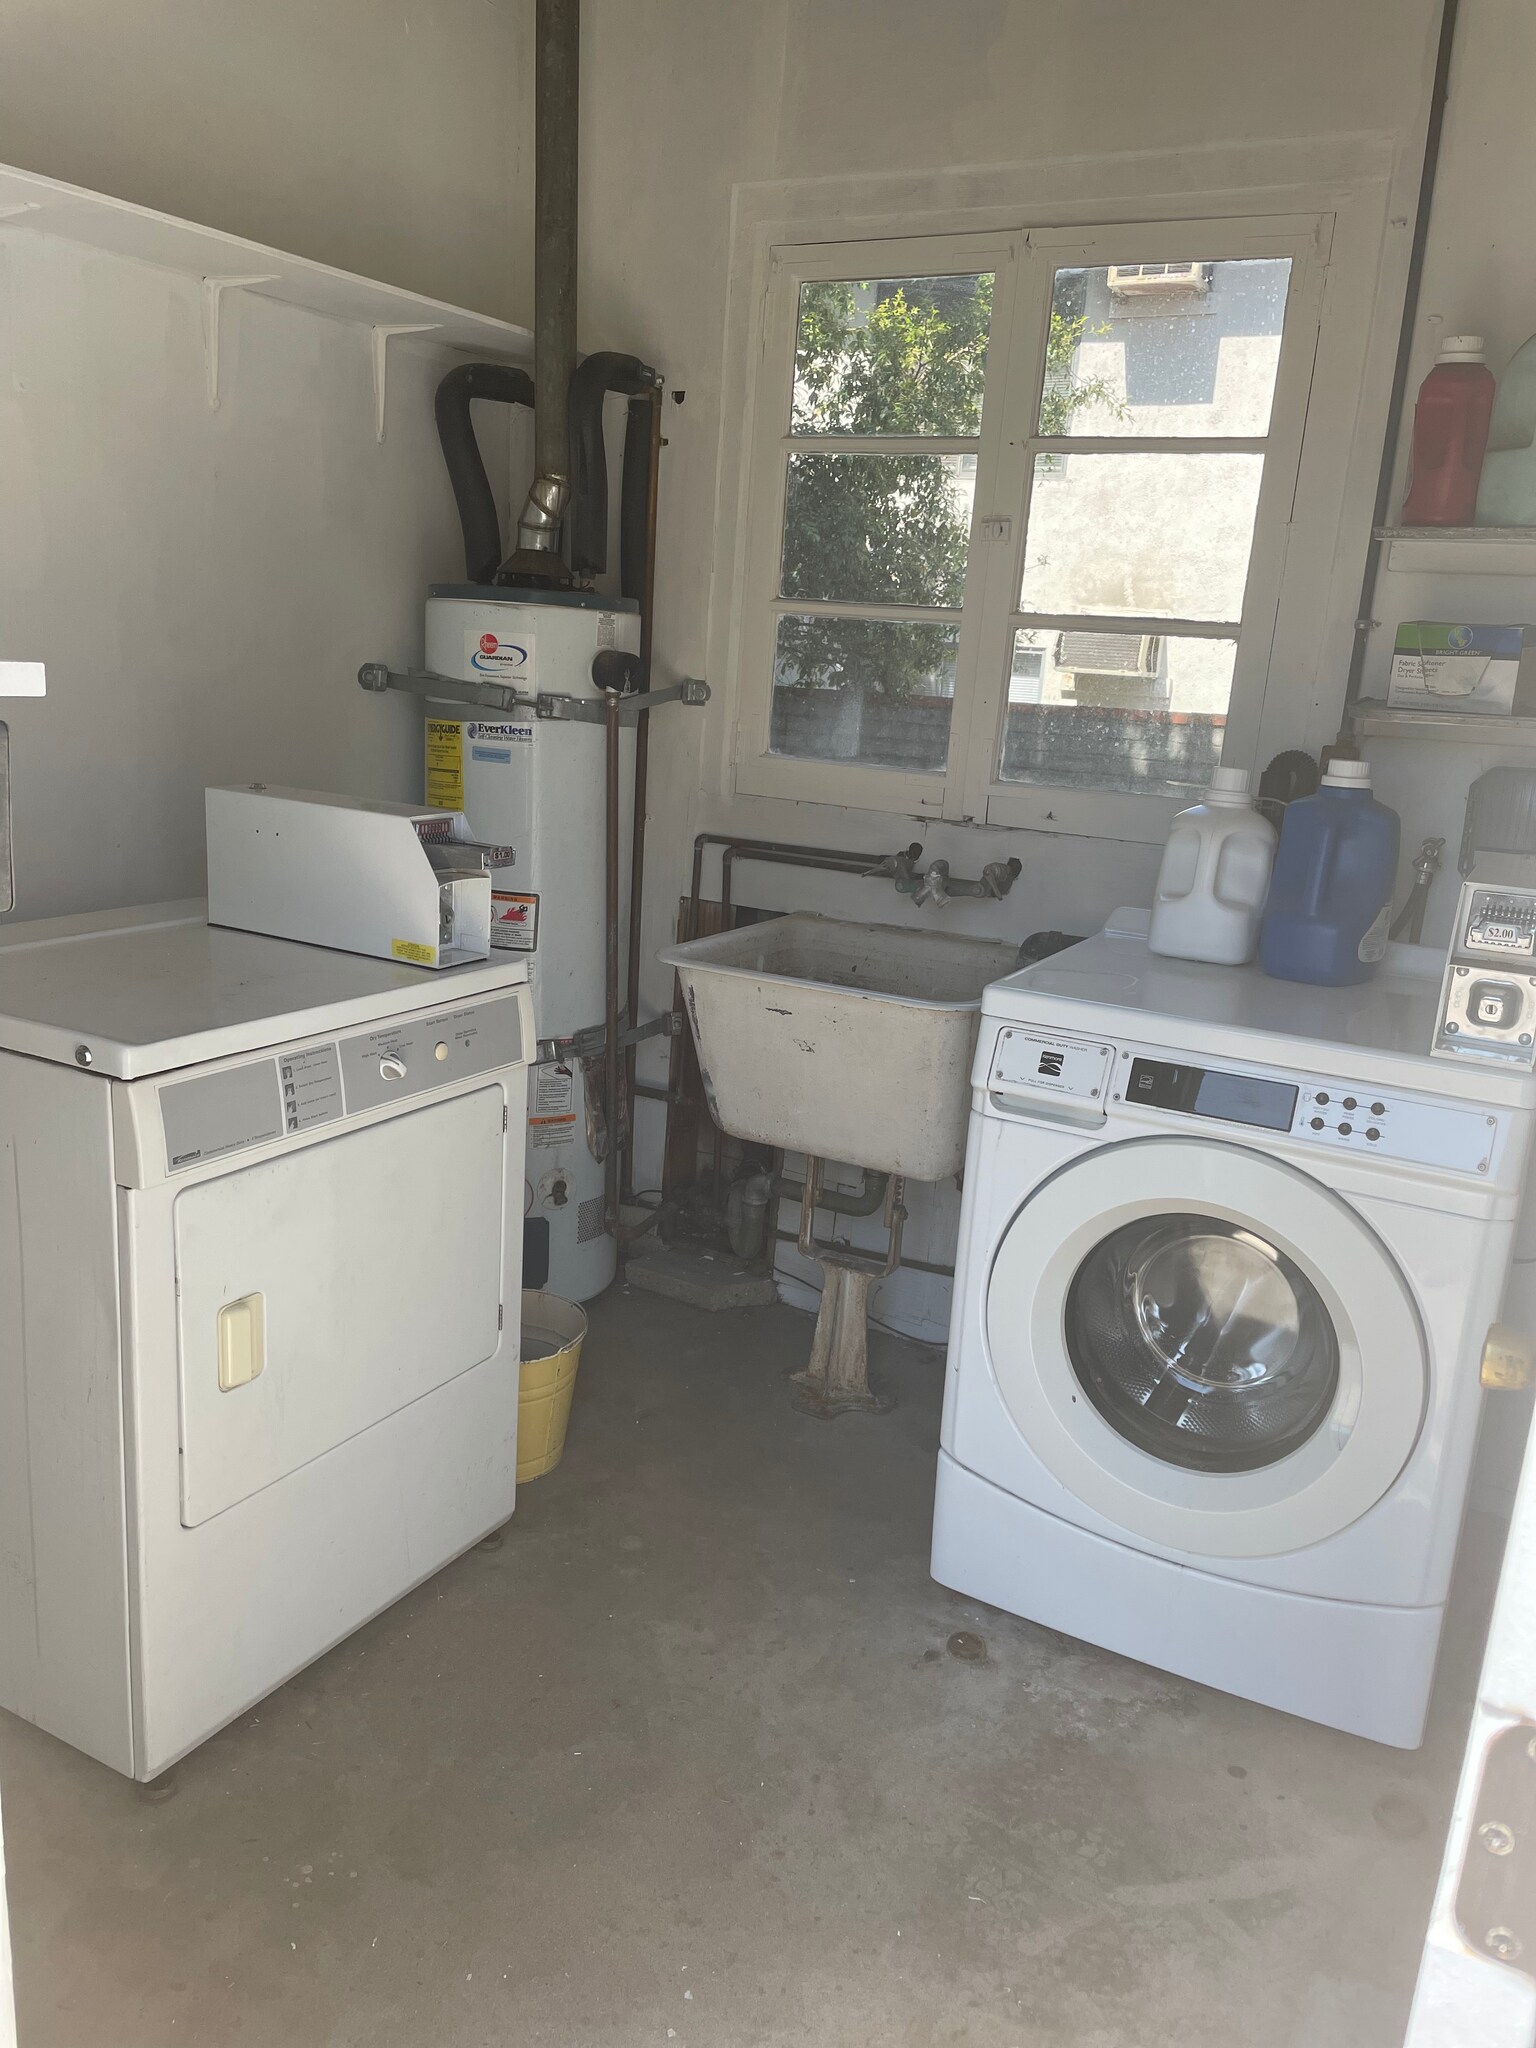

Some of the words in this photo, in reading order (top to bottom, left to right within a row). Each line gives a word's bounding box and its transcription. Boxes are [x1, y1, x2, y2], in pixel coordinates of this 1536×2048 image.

[1397, 667, 1415, 675] Dryer
[478, 723, 532, 736] EverKleen
[495, 851, 511, 859] $1.00
[1488, 927, 1514, 939] $2.00
[377, 1030, 402, 1039] Temperature
[1024, 1037, 1055, 1046] COMMERCIAL
[283, 1053, 306, 1063] Operating
[306, 1047, 331, 1056] Instructions
